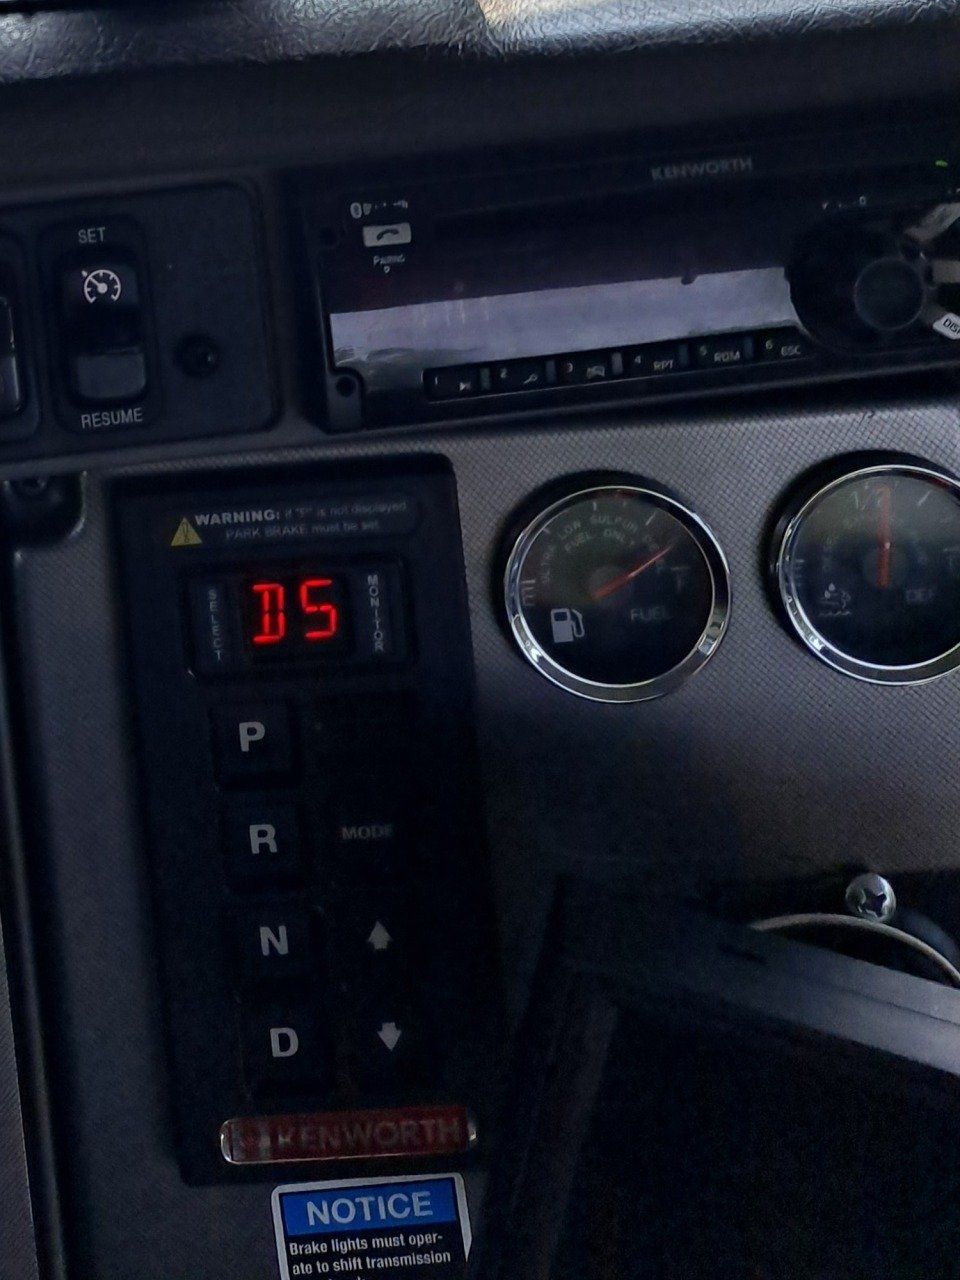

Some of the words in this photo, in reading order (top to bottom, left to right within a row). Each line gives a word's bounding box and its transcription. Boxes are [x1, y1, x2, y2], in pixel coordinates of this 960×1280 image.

[651, 156, 752, 180] KENWORTH
[78, 227, 106, 244] SET
[81, 407, 143, 429] RESUME
[194, 508, 281, 526] WARNING:
[207, 588, 223, 663] SELECT
[366, 574, 385, 653] MONITOR
[630, 607, 670, 623] FUEL
[239, 721, 266, 753] P
[249, 823, 278, 855] R
[342, 823, 395, 841] MODE
[259, 925, 289, 956] N
[270, 1027, 299, 1058] D
[306, 1190, 434, 1227] NOTICE
[290, 1241, 327, 1256] Brake
[331, 1238, 368, 1256] lights
[372, 1235, 405, 1250] must
[408, 1233, 444, 1249] oper-
[316, 1261, 330, 1274] to
[333, 1257, 364, 1272] shift
[366, 1250, 451, 1270] transmission
